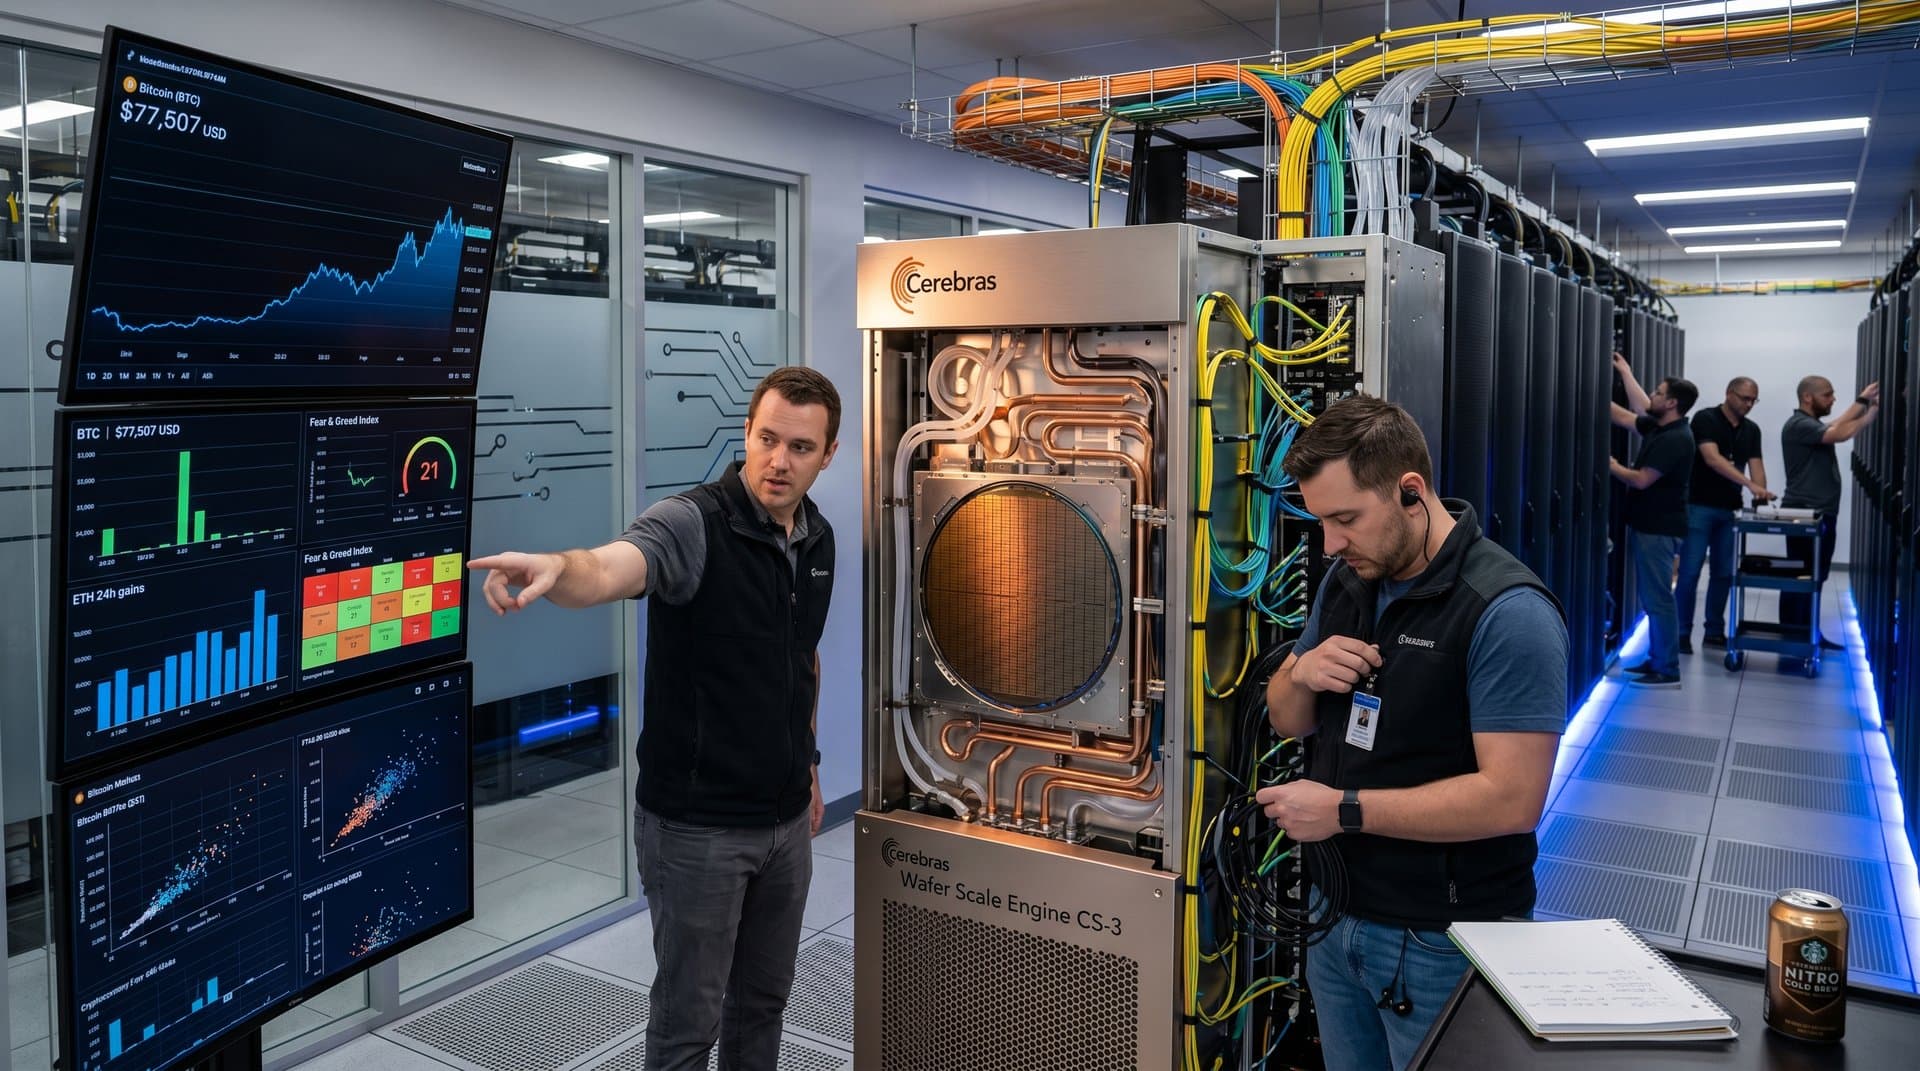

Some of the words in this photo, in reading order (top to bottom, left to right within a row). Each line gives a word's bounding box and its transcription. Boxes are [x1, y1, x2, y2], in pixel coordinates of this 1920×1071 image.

[139, 82, 174, 99] Bitcoin
[175, 91, 201, 107] (BTC)
[120, 99, 201, 134] $77,507
[203, 124, 227, 140] USD
[906, 270, 997, 293] Cerebras
[309, 417, 327, 427] Fear
[328, 416, 334, 426] &
[335, 416, 358, 426] Greed
[358, 415, 380, 425] Index
[77, 427, 100, 440] BTC
[115, 425, 157, 439] $77,507
[158, 424, 180, 435] USD
[420, 460, 439, 481] 21
[304, 553, 322, 564] Fear
[322, 551, 328, 561] &
[329, 548, 352, 560] Greed
[353, 545, 373, 556] Index
[72, 592, 95, 606] ETH
[96, 588, 116, 601] 24h
[118, 583, 145, 599] gains
[900, 870, 950, 897] Wafer
[955, 883, 1002, 909] Scale
[1008, 894, 1071, 924] Engine
[1077, 910, 1122, 936] CS-3
[1784, 979, 1812, 991] COLD
[1814, 984, 1839, 993] BREW
[1785, 966, 1840, 985] NITRO
